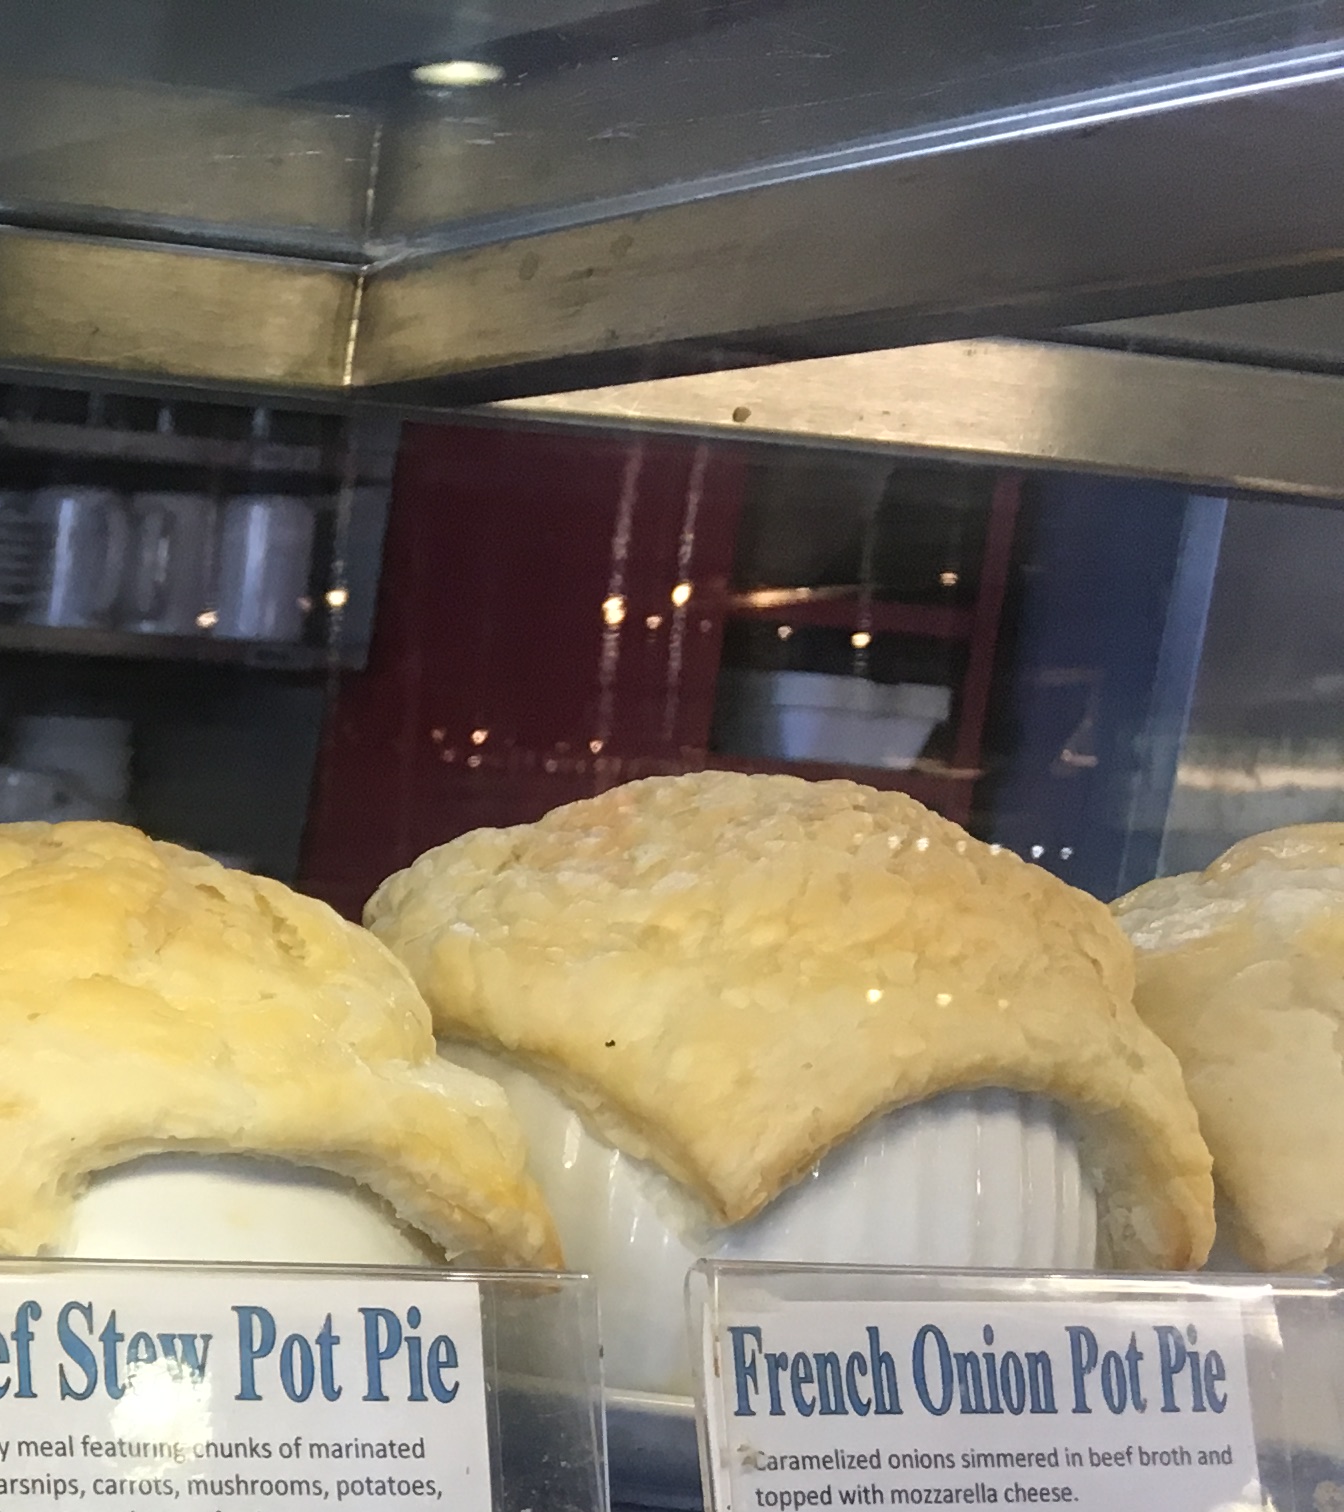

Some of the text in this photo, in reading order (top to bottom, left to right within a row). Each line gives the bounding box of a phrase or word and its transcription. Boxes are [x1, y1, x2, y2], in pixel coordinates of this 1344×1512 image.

[231, 1305, 342, 1403] Pot
[359, 1305, 460, 1403] Pie
[727, 1323, 1228, 1418] French Onion Pot Pie
[17, 1434, 74, 1458] meal
[81, 1434, 185, 1463] featuring
[193, 1437, 272, 1459] chunks
[278, 1436, 303, 1459] of
[308, 1437, 426, 1459] marinated
[888, 1448, 956, 1470] onions
[961, 1447, 1060, 1469] simmered
[1065, 1447, 1084, 1468] in
[1088, 1445, 1134, 1468] beef
[1139, 1445, 1192, 1467] broth
[1197, 1444, 1234, 1467] and
[92, 1474, 180, 1499] carrots,
[187, 1474, 329, 1500] mushrooms,
[336, 1476, 443, 1501] potatoes,
[755, 1482, 1080, 1511] topped with mozzarella cheese.
